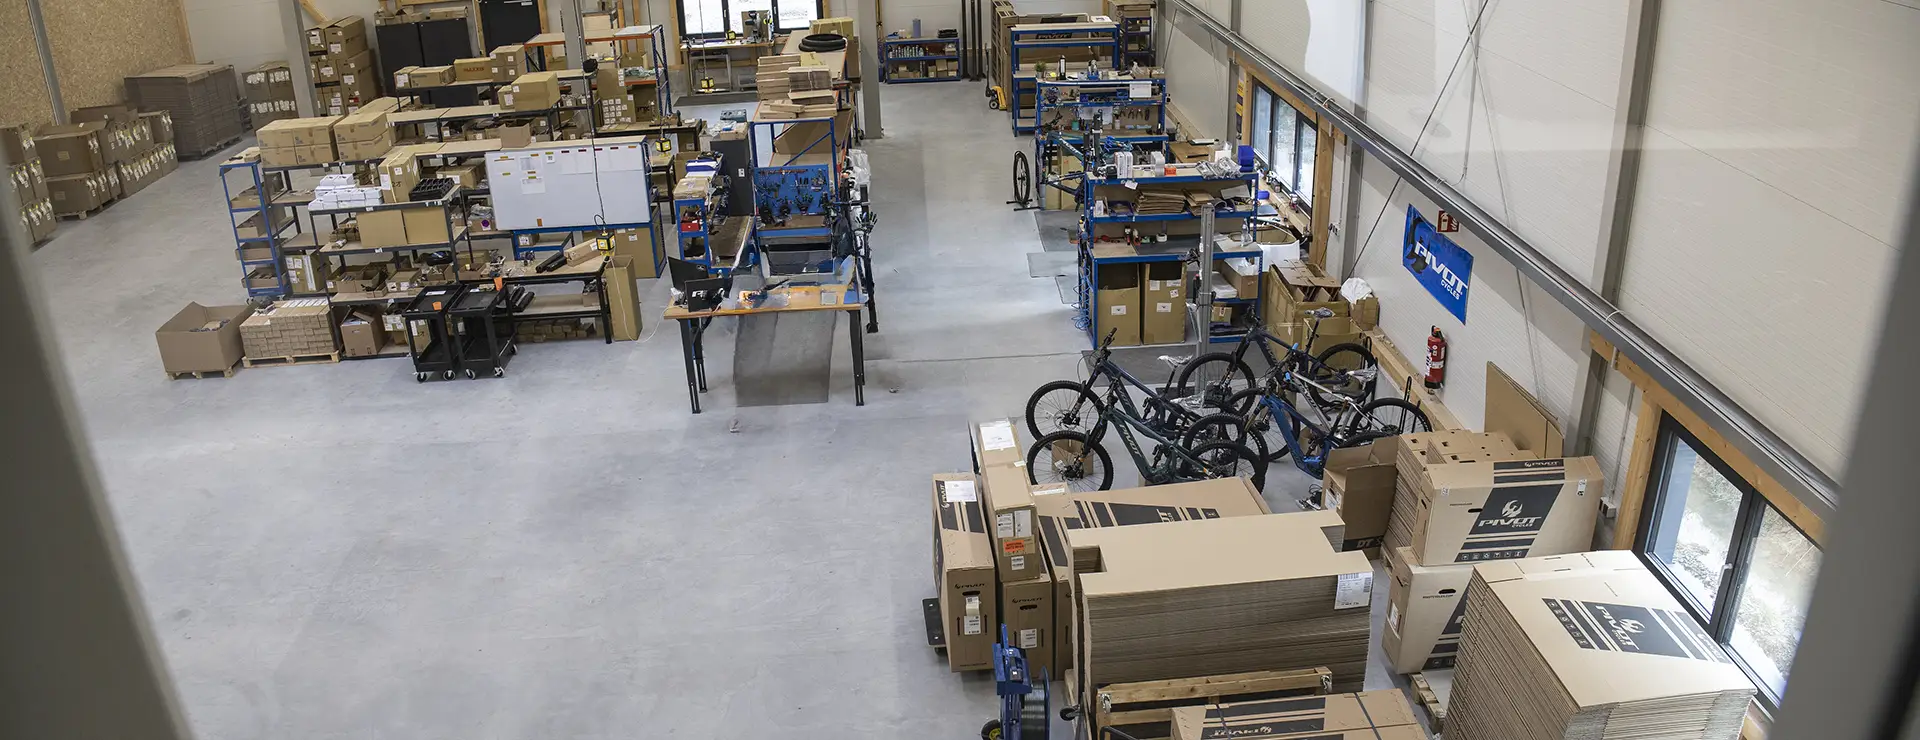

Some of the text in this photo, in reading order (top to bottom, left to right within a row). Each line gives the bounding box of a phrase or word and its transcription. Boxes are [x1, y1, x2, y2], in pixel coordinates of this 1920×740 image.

[1414, 241, 1469, 293] PIVOT
[1440, 279, 1461, 300] CYCLES
[1119, 424, 1142, 457] PIVOT
[1478, 516, 1542, 527] PIVOT
[1356, 539, 1373, 548] DT
[1595, 605, 1640, 650] PIVOT
